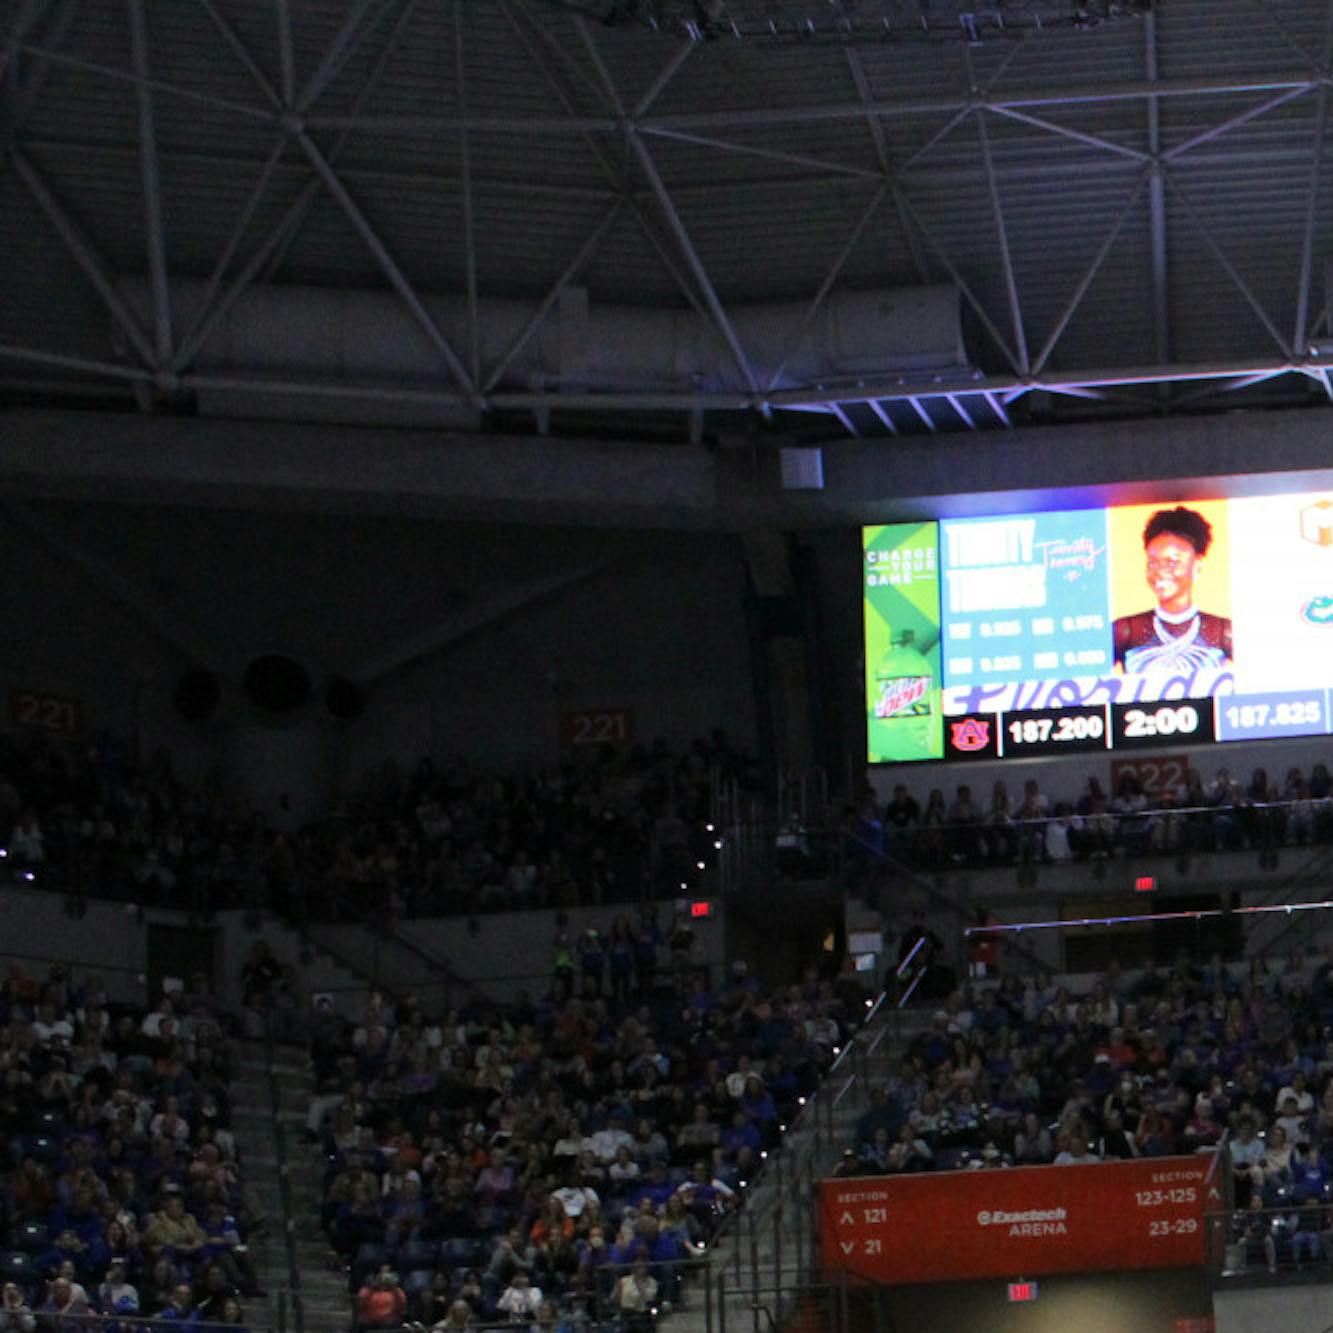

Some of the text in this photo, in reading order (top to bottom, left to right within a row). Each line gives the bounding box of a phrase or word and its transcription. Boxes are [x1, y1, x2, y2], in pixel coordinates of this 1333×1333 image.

[867, 547, 936, 563] CHARGE
[867, 572, 913, 586] GAME
[18, 697, 75, 731] 221
[1123, 706, 1199, 738] 2:00
[1226, 701, 1321, 729] 187.825
[573, 714, 625, 743] 221
[1009, 715, 1104, 743] 187.200
[1152, 1171, 1203, 1182] SECTION
[838, 1191, 888, 1203] SECTION
[1136, 1187, 1196, 1205] 123-125
[863, 1208, 887, 1224] 121
[1008, 1221, 1067, 1237] ARENA
[1150, 1219, 1197, 1236] 23-29
[864, 1239, 881, 1255] 21
